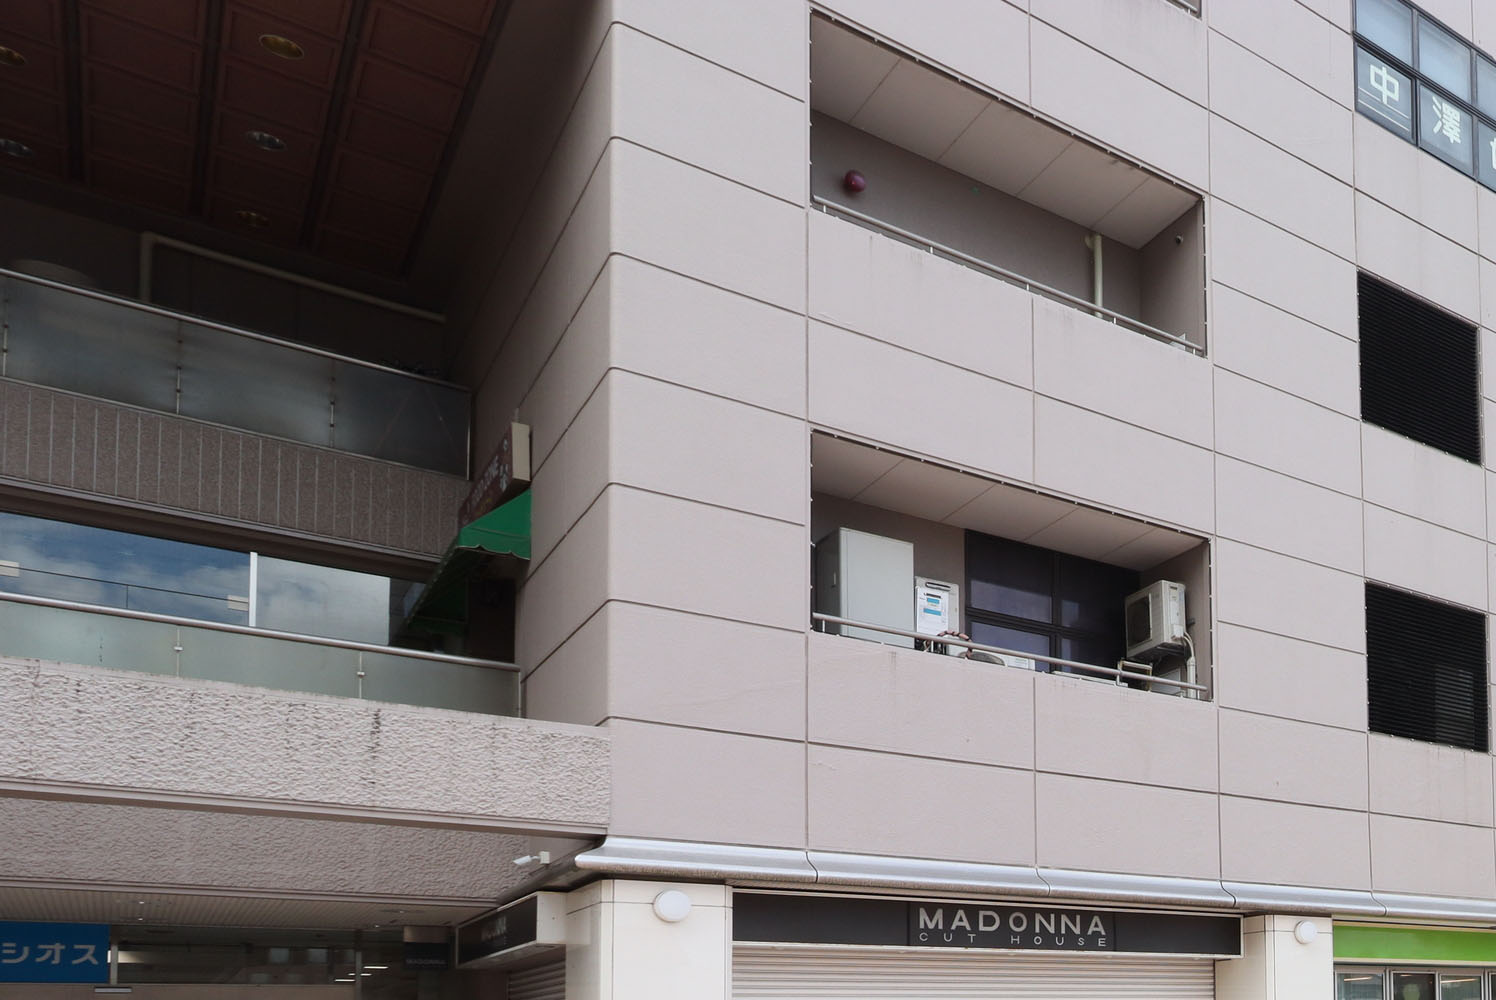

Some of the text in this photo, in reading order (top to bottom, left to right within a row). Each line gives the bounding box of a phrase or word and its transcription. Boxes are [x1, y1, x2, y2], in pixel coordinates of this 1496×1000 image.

[919, 907, 1106, 936] MADONNA
[919, 932, 1107, 947] CUT HOUSE
[2, 942, 99, 965] シオス
